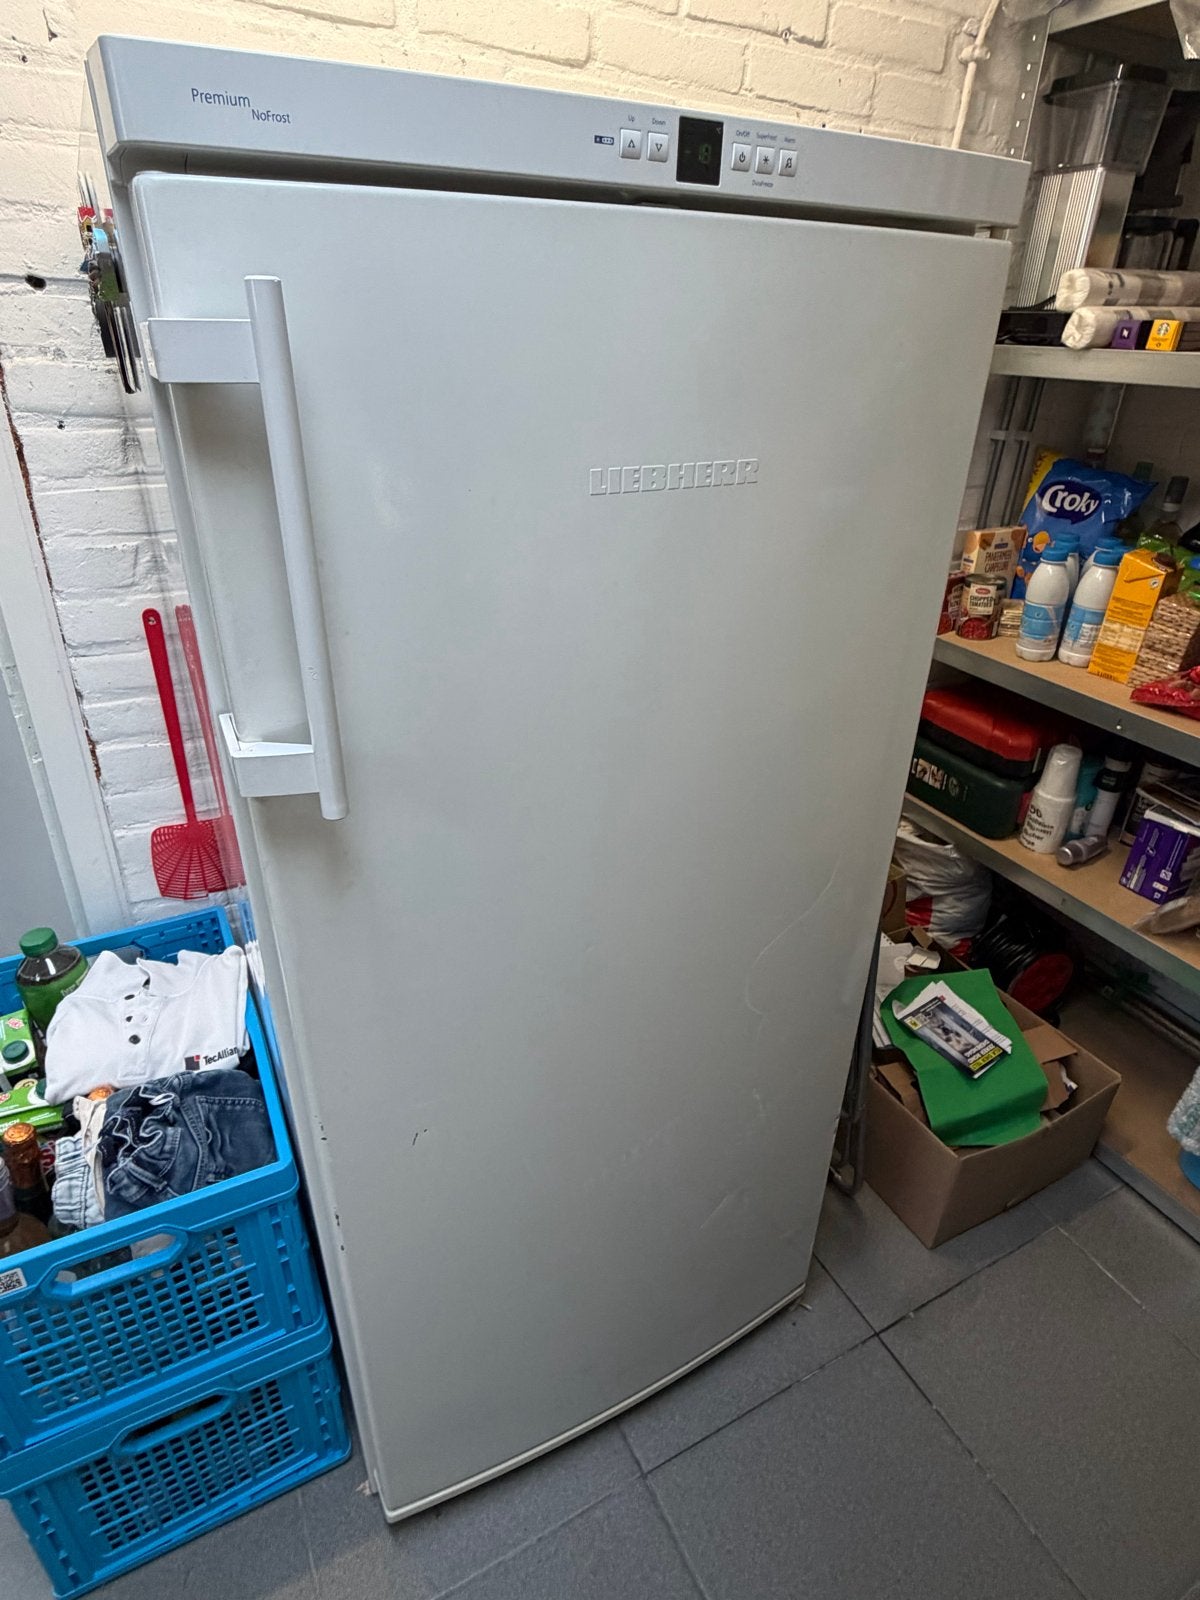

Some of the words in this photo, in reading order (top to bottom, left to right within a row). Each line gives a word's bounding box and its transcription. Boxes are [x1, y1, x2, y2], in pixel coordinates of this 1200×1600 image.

[191, 88, 251, 108] Premium
[251, 108, 292, 124] NoFrost
[627, 114, 636, 123] Up
[651, 117, 667, 126] Down
[589, 458, 759, 497] LIEBHERR
[1041, 484, 1100, 517] Croky
